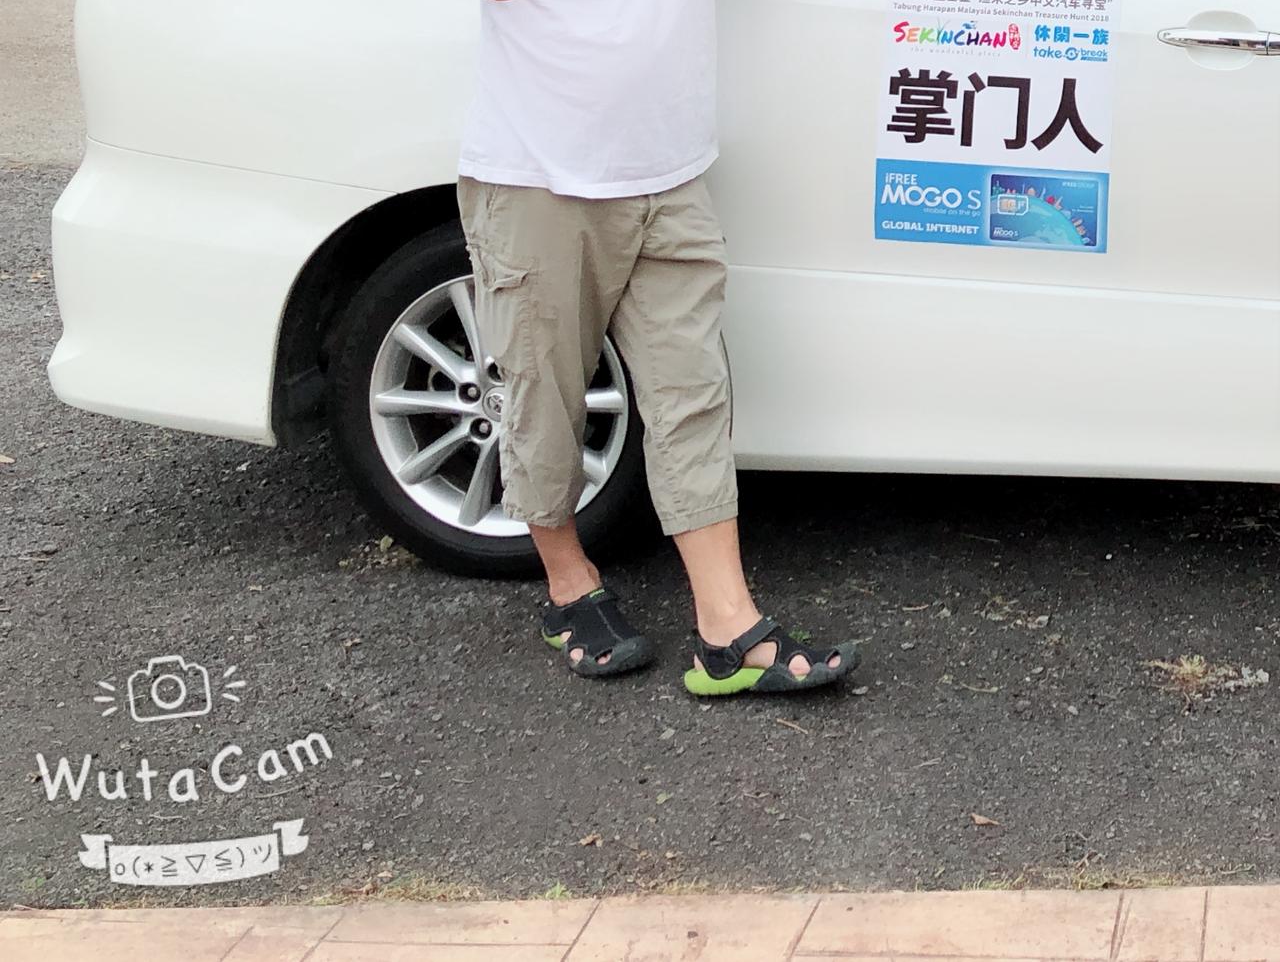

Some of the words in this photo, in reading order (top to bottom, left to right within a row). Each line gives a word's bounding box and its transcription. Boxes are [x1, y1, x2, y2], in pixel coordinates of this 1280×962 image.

[893, 2, 921, 12] Tabung
[923, 3, 956, 13] Harapan
[957, 6, 991, 16] Malaysia
[993, 8, 1033, 18] Sekinchan
[1035, 11, 1068, 20] Treasure
[1070, 13, 1089, 21] Hunt
[1091, 14, 1109, 22] 2018
[894, 21, 1007, 48] SEKINCHAN
[1033, 45, 1062, 59] take
[1080, 47, 1108, 57] break
[886, 67, 1104, 154] 掌门人
[885, 172, 918, 185] iFREE
[880, 184, 962, 209] MOGO
[967, 189, 981, 210] S
[881, 220, 924, 231] GLOBAL
[925, 223, 980, 235] INTERNET
